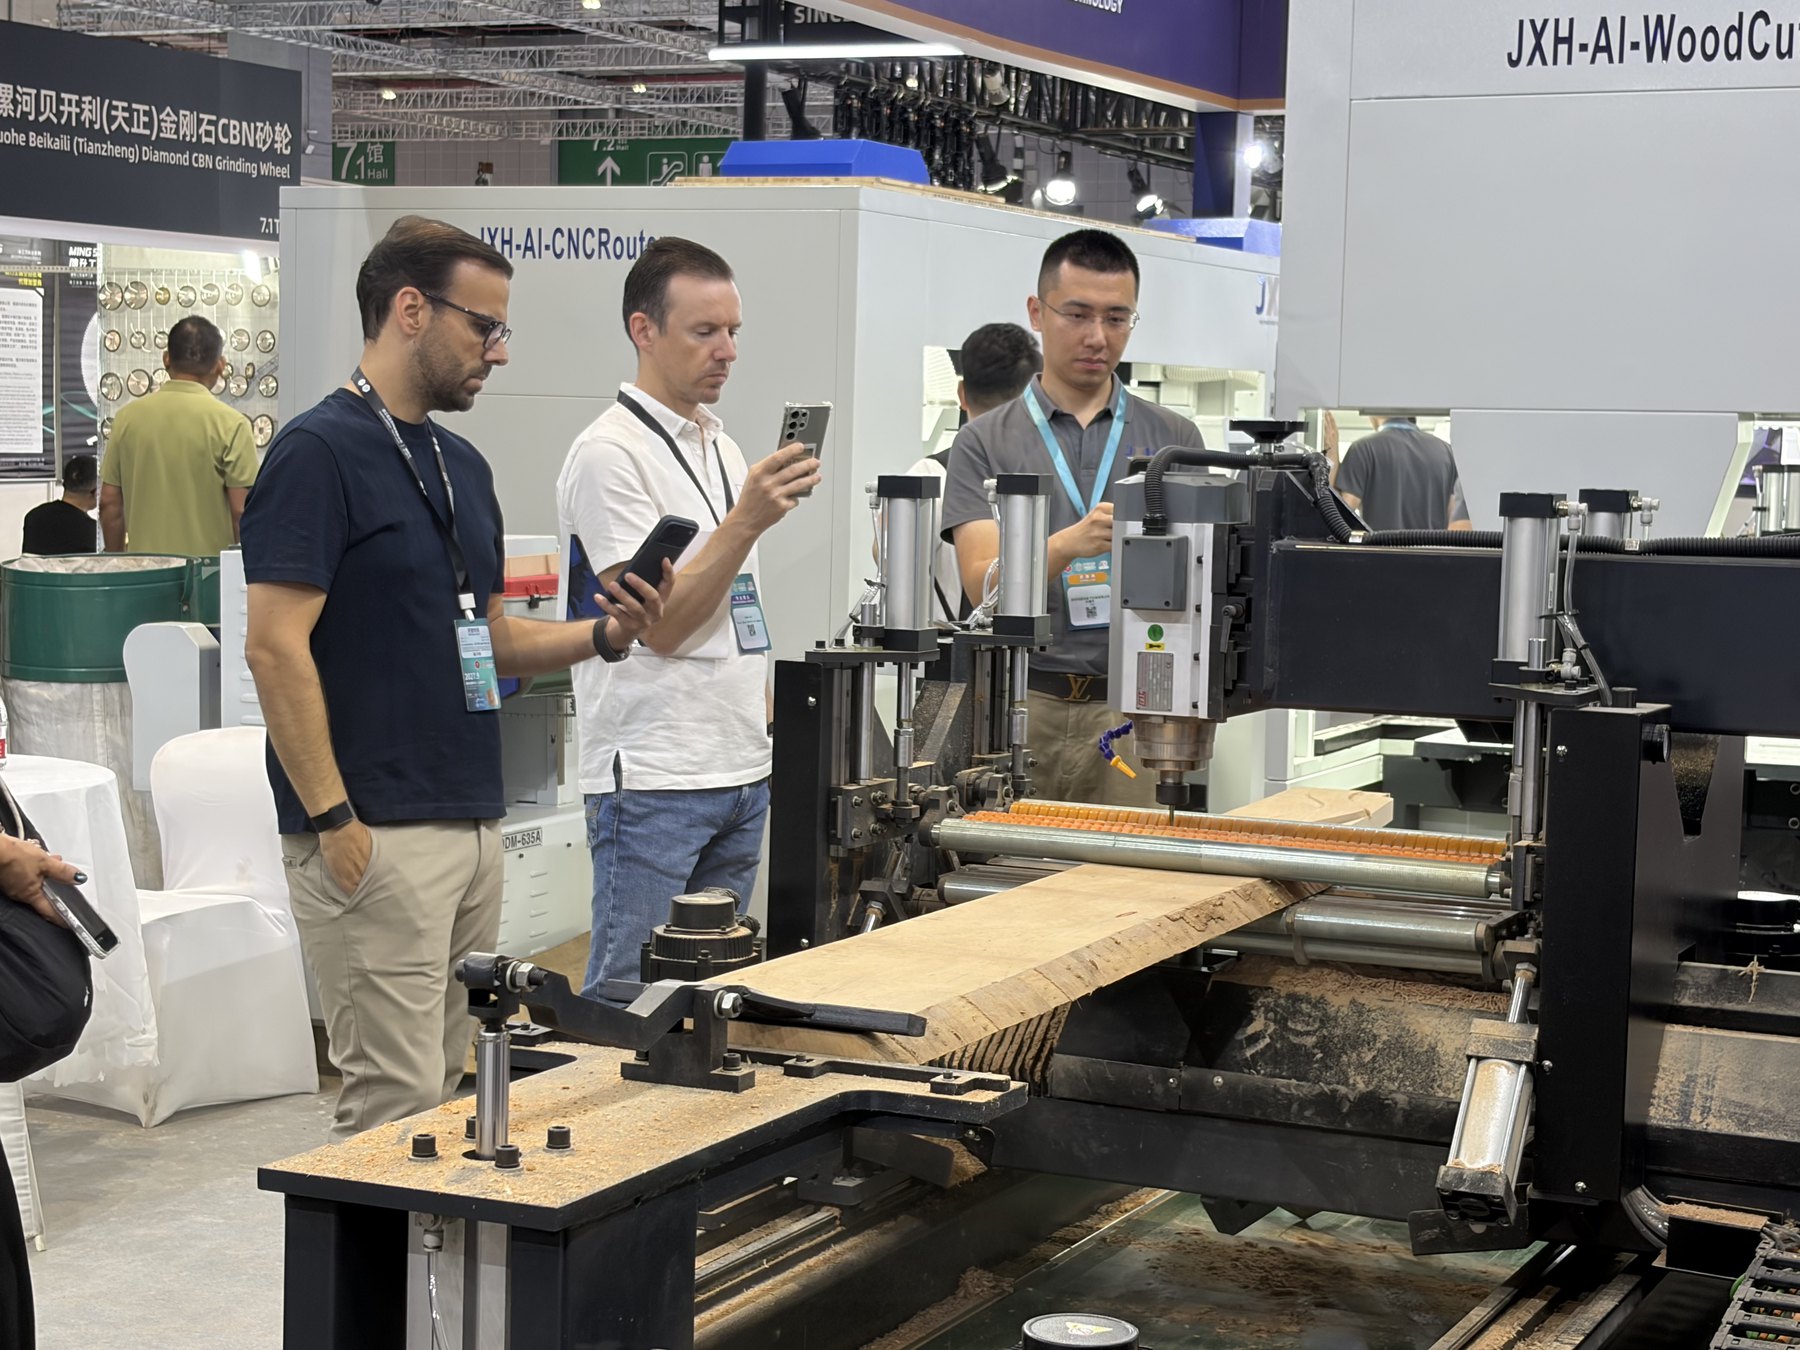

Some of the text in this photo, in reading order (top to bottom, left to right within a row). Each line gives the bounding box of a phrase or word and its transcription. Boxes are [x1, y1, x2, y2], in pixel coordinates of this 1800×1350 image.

[1507, 10, 1800, 68] JXH-AI-WoodCu
[29, 131, 71, 152] Beikaili
[73, 136, 139, 164] (Tianzheng)
[142, 146, 189, 167] Diamond
[192, 153, 213, 169] CBN
[215, 156, 258, 178] Grinding
[260, 161, 291, 179] Wheel
[336, 142, 384, 180] 7.1 馆
[367, 168, 388, 180] Hall
